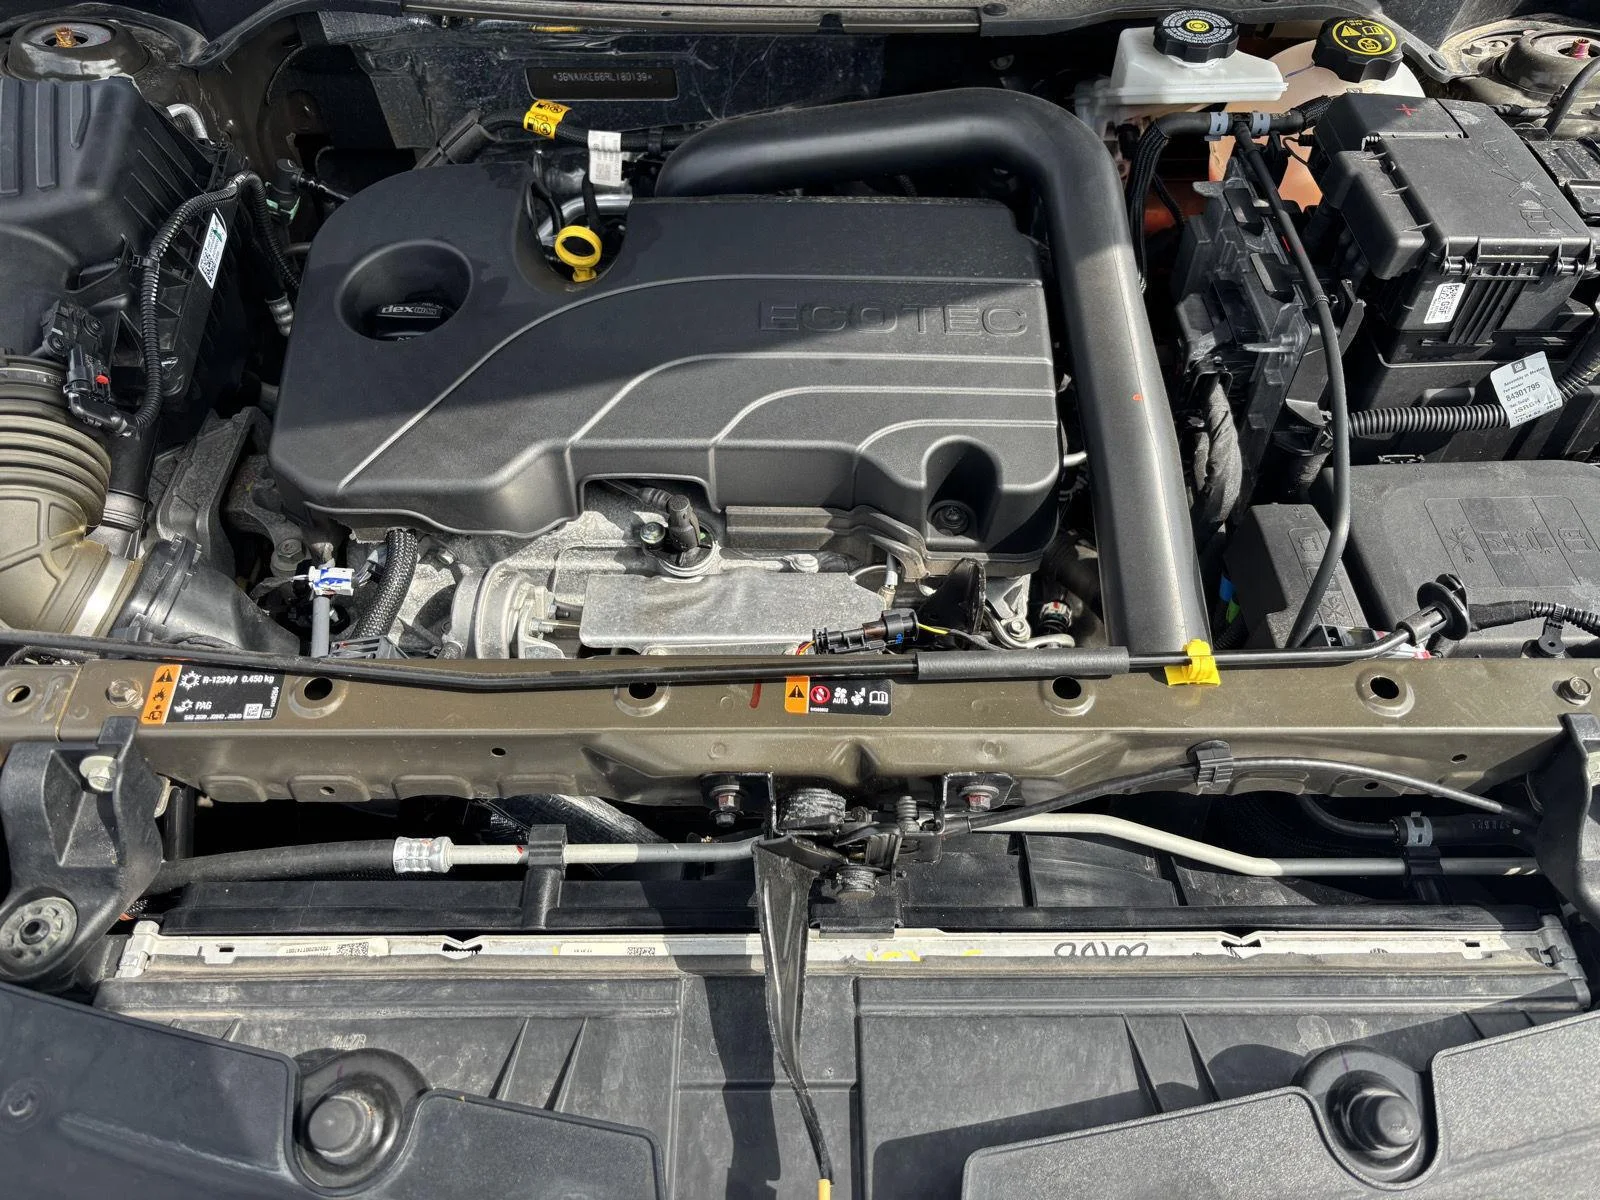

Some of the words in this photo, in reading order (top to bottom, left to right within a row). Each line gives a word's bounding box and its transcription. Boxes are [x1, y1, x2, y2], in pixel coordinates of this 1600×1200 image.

[758, 302, 1028, 337] ECOTEC
[1505, 381, 1541, 402] 84301795
[202, 675, 238, 685] R-1234yf
[241, 675, 264, 684] 0.450
[264, 674, 275, 684] kg
[195, 701, 212, 710] PAG
